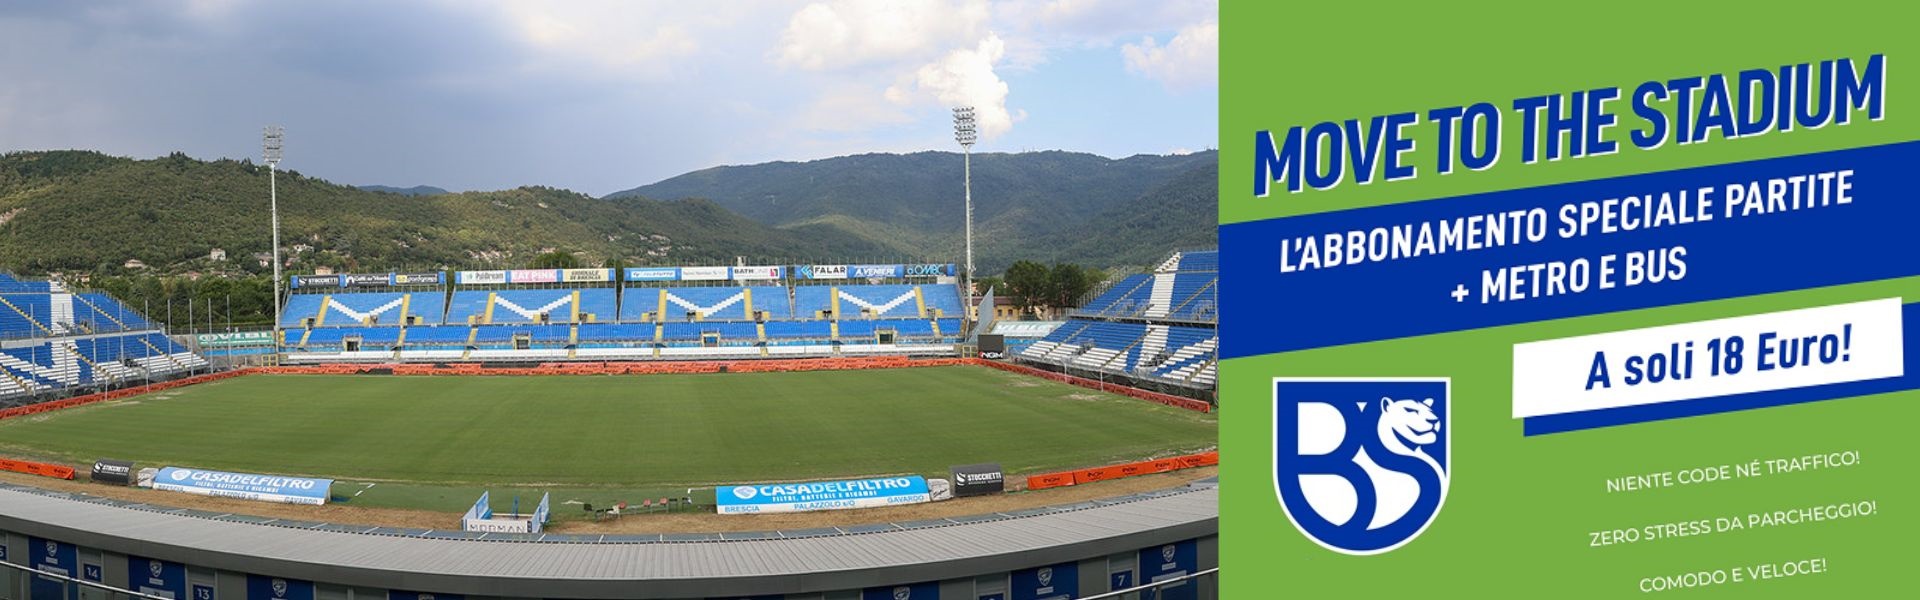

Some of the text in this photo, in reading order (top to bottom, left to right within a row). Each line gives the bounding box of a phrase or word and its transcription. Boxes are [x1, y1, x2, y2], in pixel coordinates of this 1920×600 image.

[814, 266, 846, 274] FALAR
[191, 471, 315, 490] CASADELFILTRO
[967, 472, 1002, 482] STOCCHETTI
[760, 476, 911, 497] CASADELFILTRO
[724, 504, 760, 513] BRESCIA
[794, 501, 841, 510] PALAZZOLO
[87, 567, 99, 578] 14
[1117, 574, 1126, 587] 7
[197, 588, 210, 600] 13
